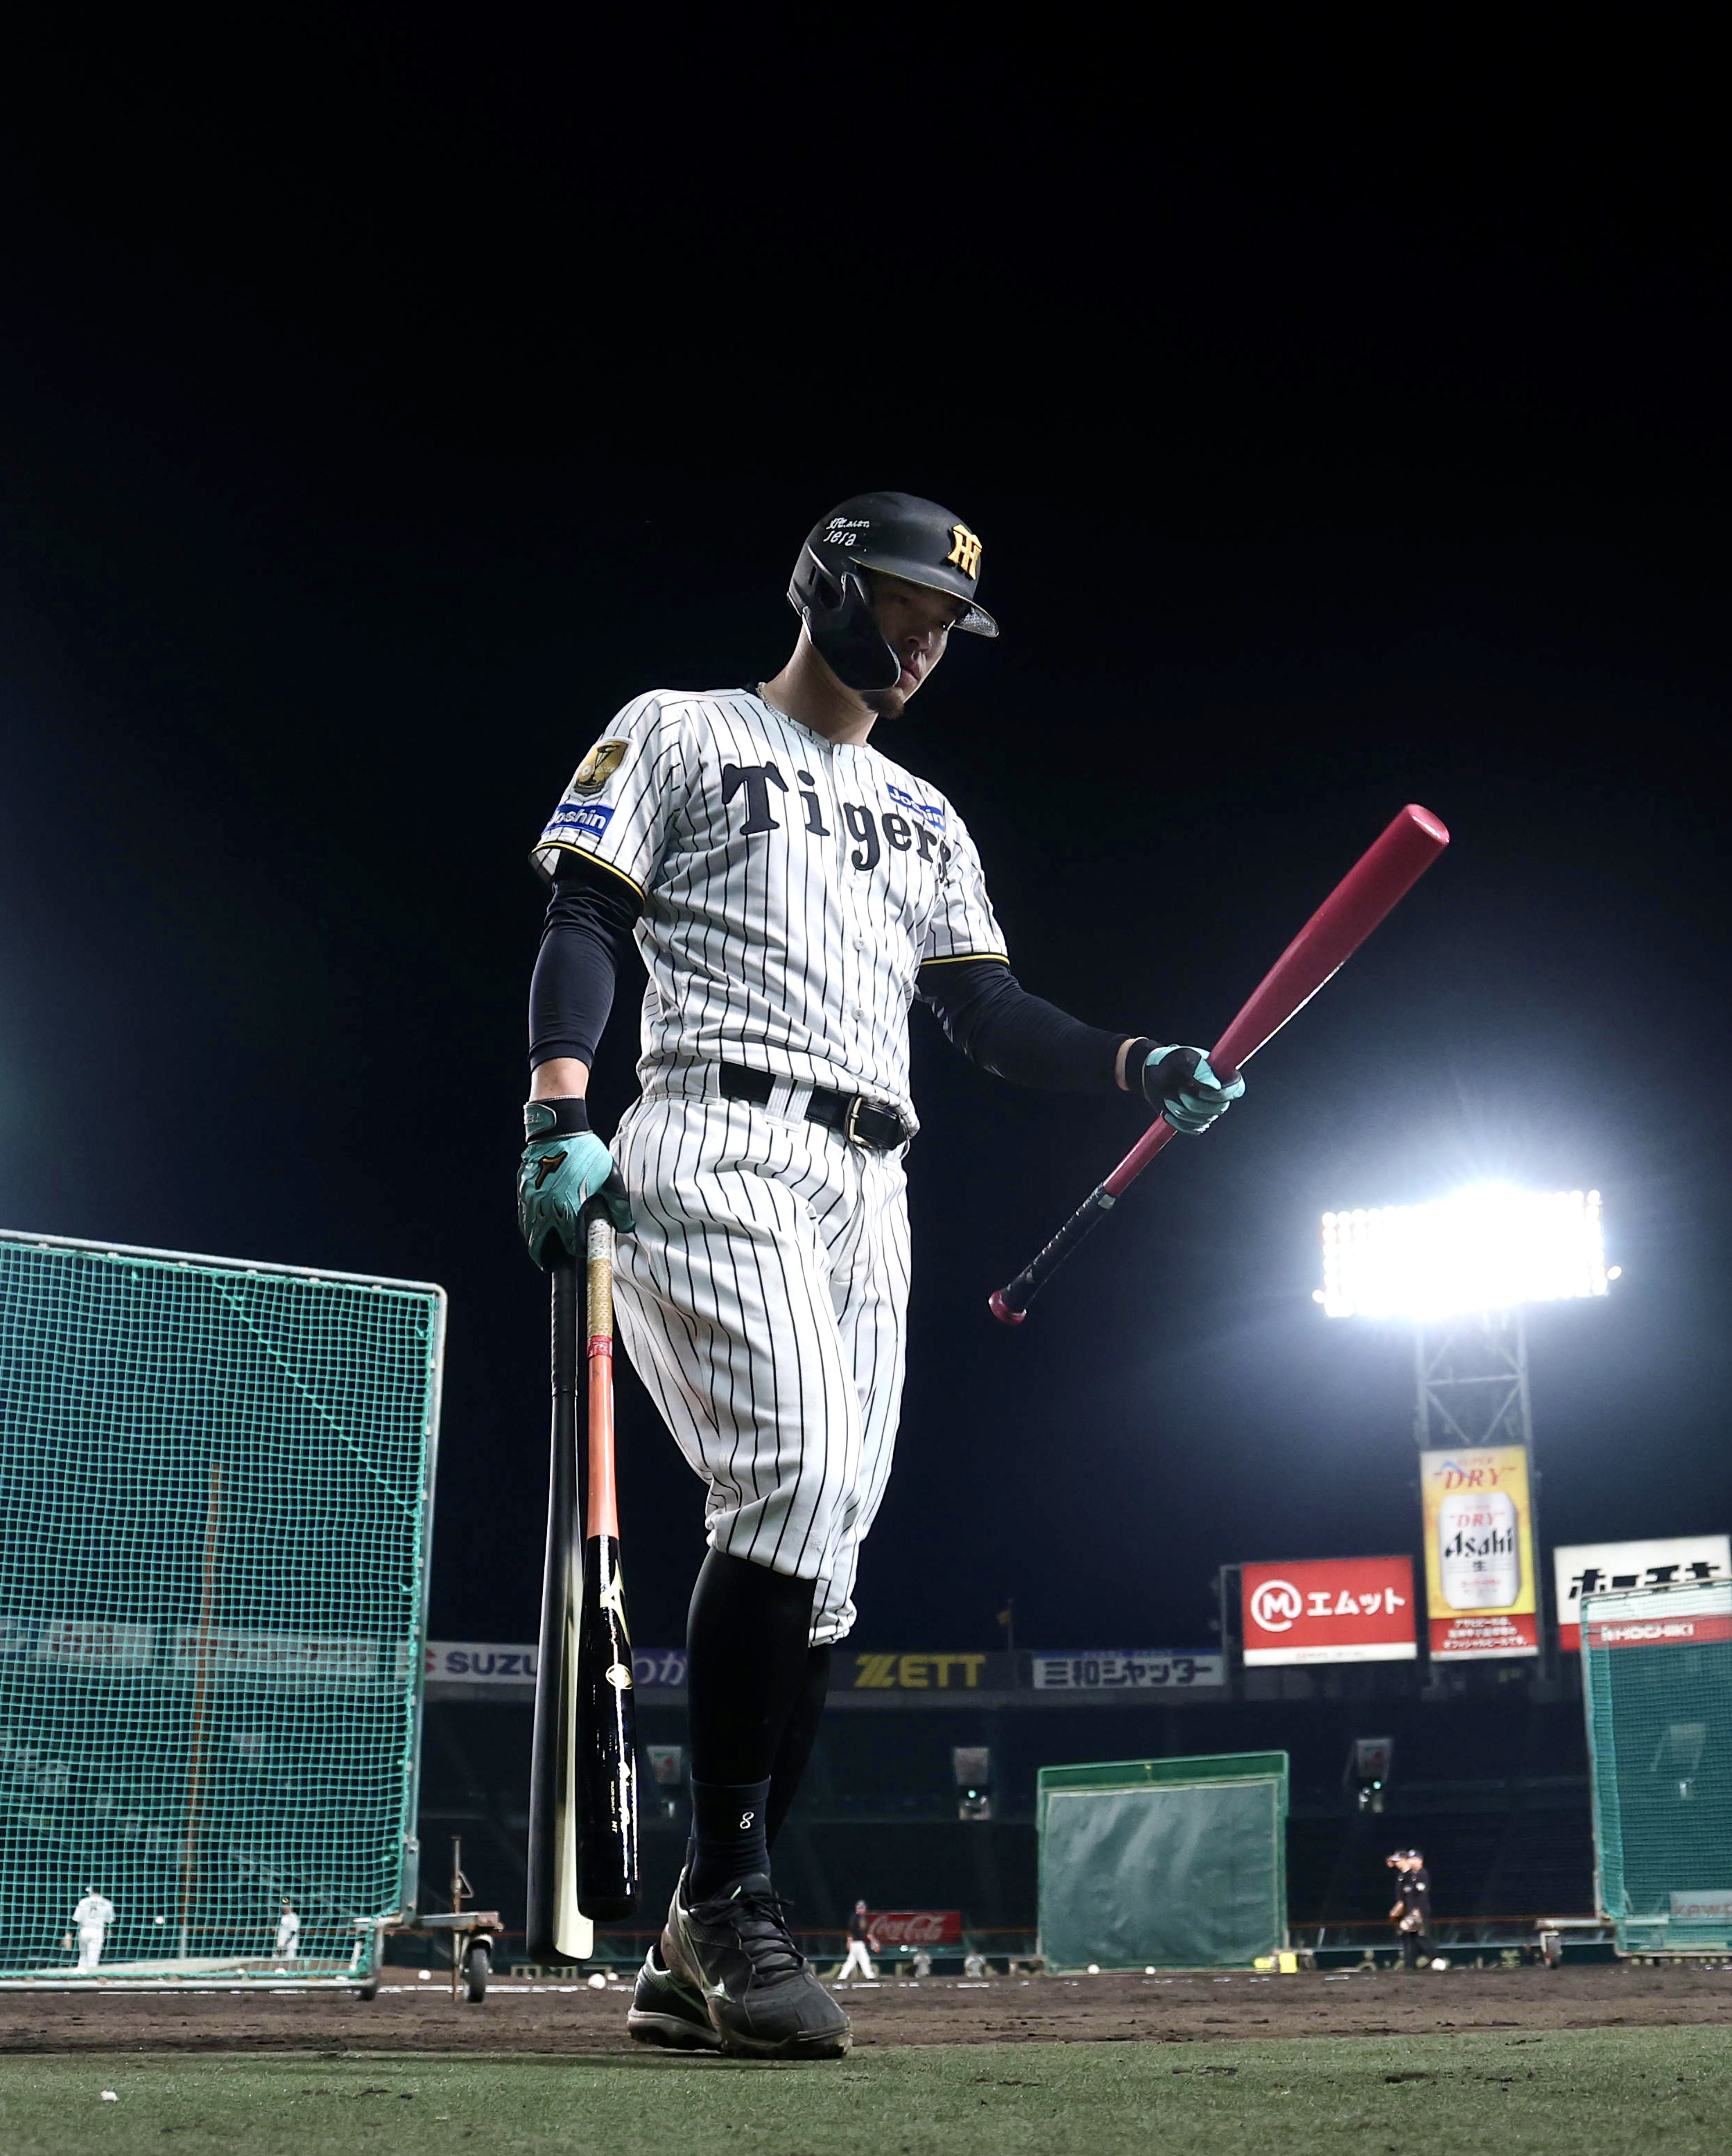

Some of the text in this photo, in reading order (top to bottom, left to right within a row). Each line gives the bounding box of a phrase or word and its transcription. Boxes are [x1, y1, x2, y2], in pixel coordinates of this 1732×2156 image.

[1445, 1528, 1513, 1558] Asahi
[854, 1654, 986, 1688] ZETT
[739, 1811, 754, 1829] 8
